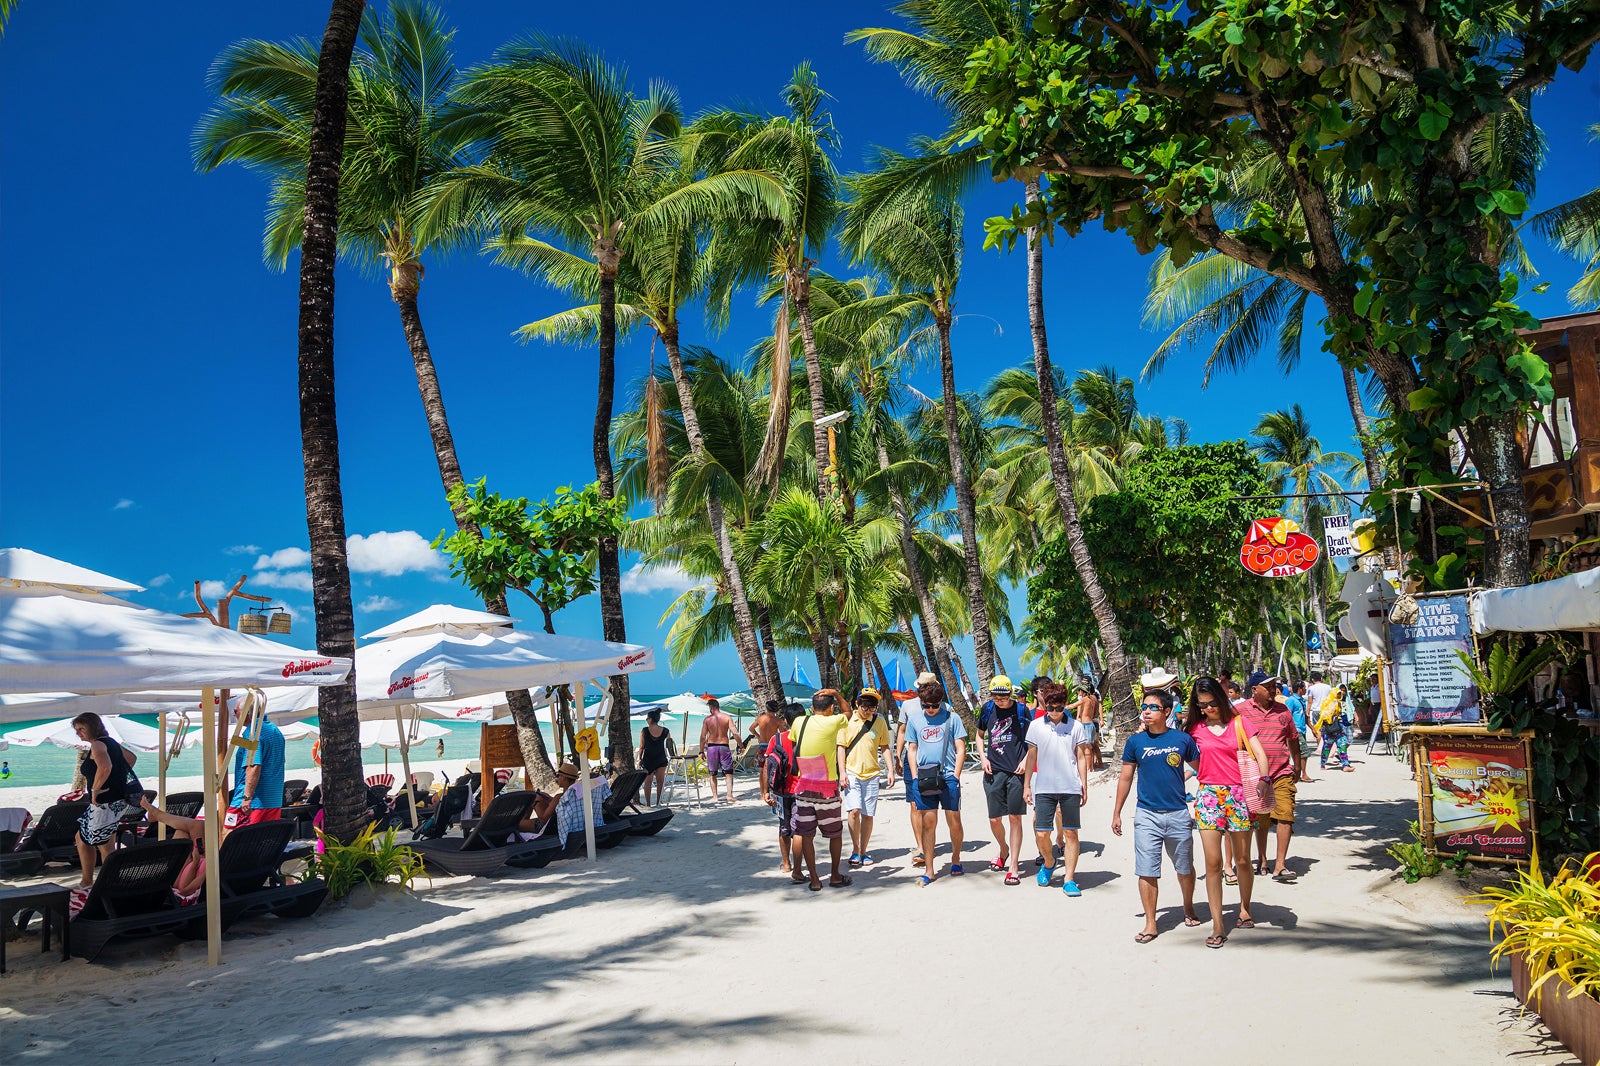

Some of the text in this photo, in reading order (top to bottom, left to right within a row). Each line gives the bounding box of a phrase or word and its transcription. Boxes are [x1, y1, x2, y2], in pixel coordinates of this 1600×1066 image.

[1324, 516, 1349, 528] FREE
[1327, 535, 1349, 546] Draft
[1328, 546, 1351, 557] Beer
[1241, 544, 1318, 572] Coco
[1272, 567, 1297, 577] BAR
[1417, 603, 1451, 616] ATIVE
[1404, 625, 1456, 639] STATION
[922, 727, 940, 739] Jeep
[1447, 834, 1526, 846] Red Coconut
